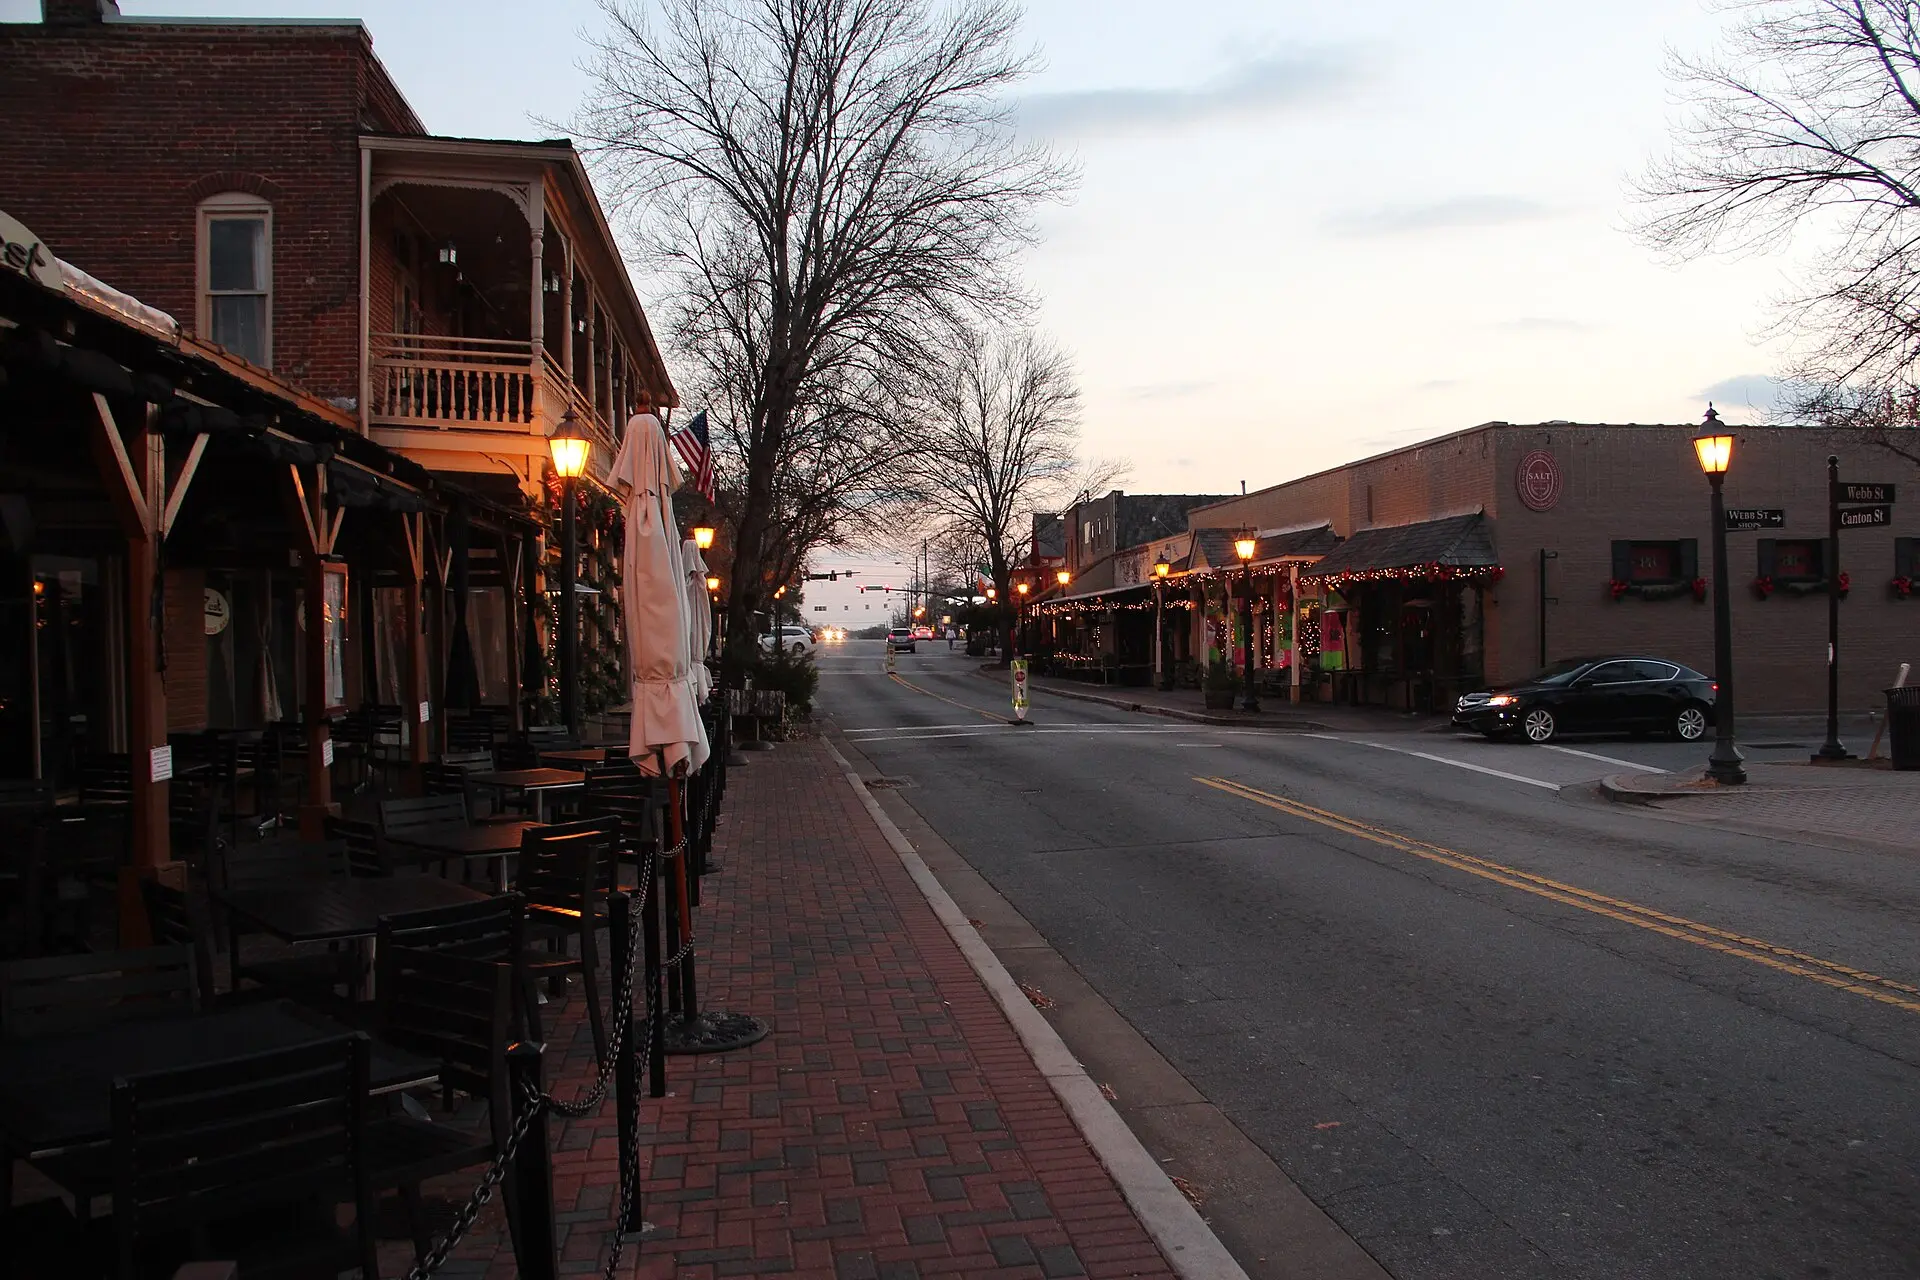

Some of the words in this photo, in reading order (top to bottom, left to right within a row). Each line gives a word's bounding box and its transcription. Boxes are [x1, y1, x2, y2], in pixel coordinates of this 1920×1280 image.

[1528, 472, 1551, 480] SALT
[1847, 486, 1873, 500] Webb
[1874, 486, 1885, 500] St
[1841, 511, 1873, 525] Canton
[1873, 508, 1884, 523] St
